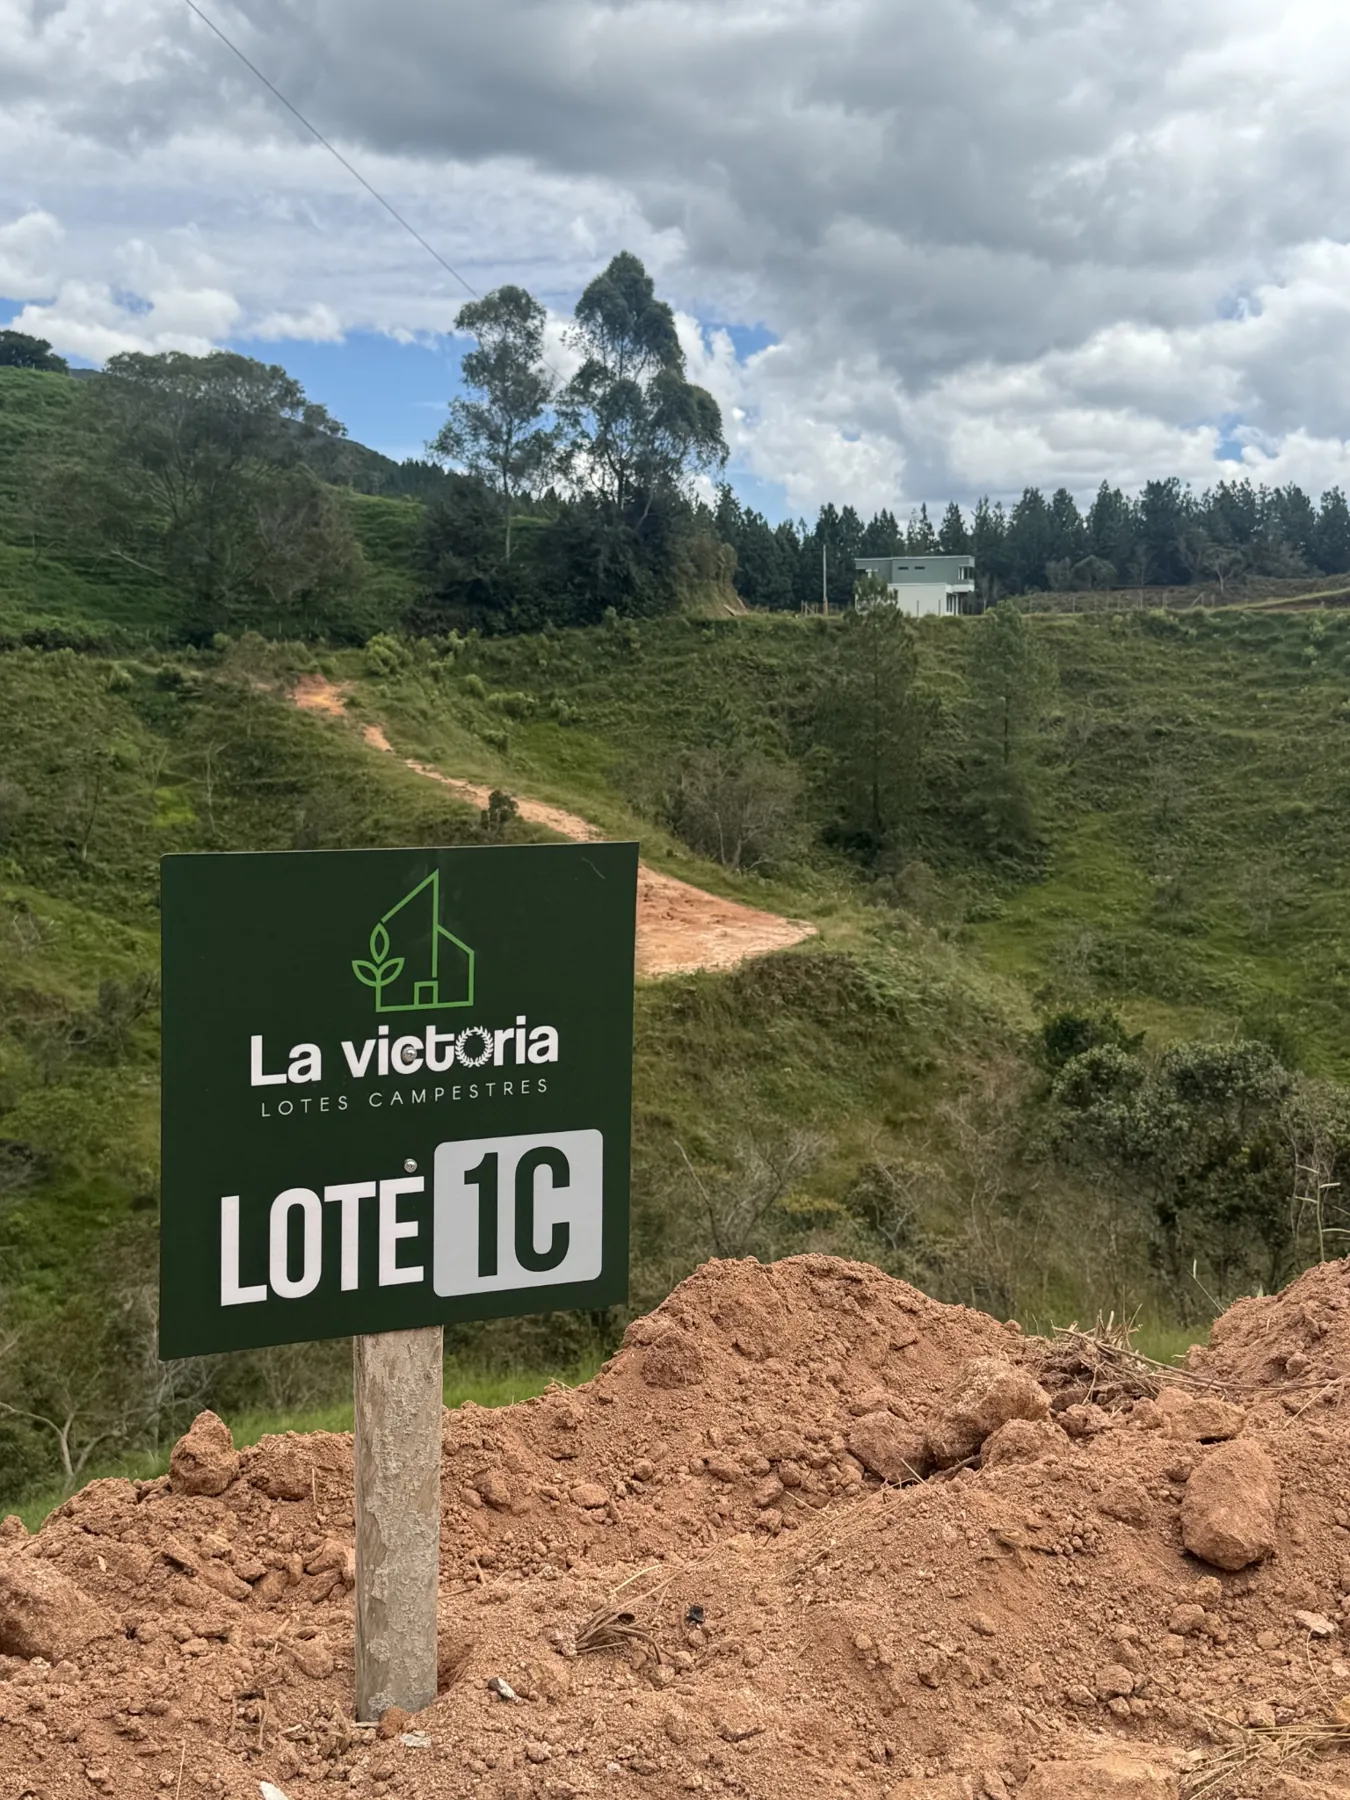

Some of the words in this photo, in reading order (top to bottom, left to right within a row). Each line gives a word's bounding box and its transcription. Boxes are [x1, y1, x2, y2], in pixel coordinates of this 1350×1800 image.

[251, 1034, 322, 1086] La
[341, 1015, 559, 1078] victoria
[262, 1096, 348, 1118] LOTES
[369, 1078, 548, 1107] CAMPESTRES
[221, 1176, 425, 1307] LOTE
[463, 1146, 570, 1278] 1C
